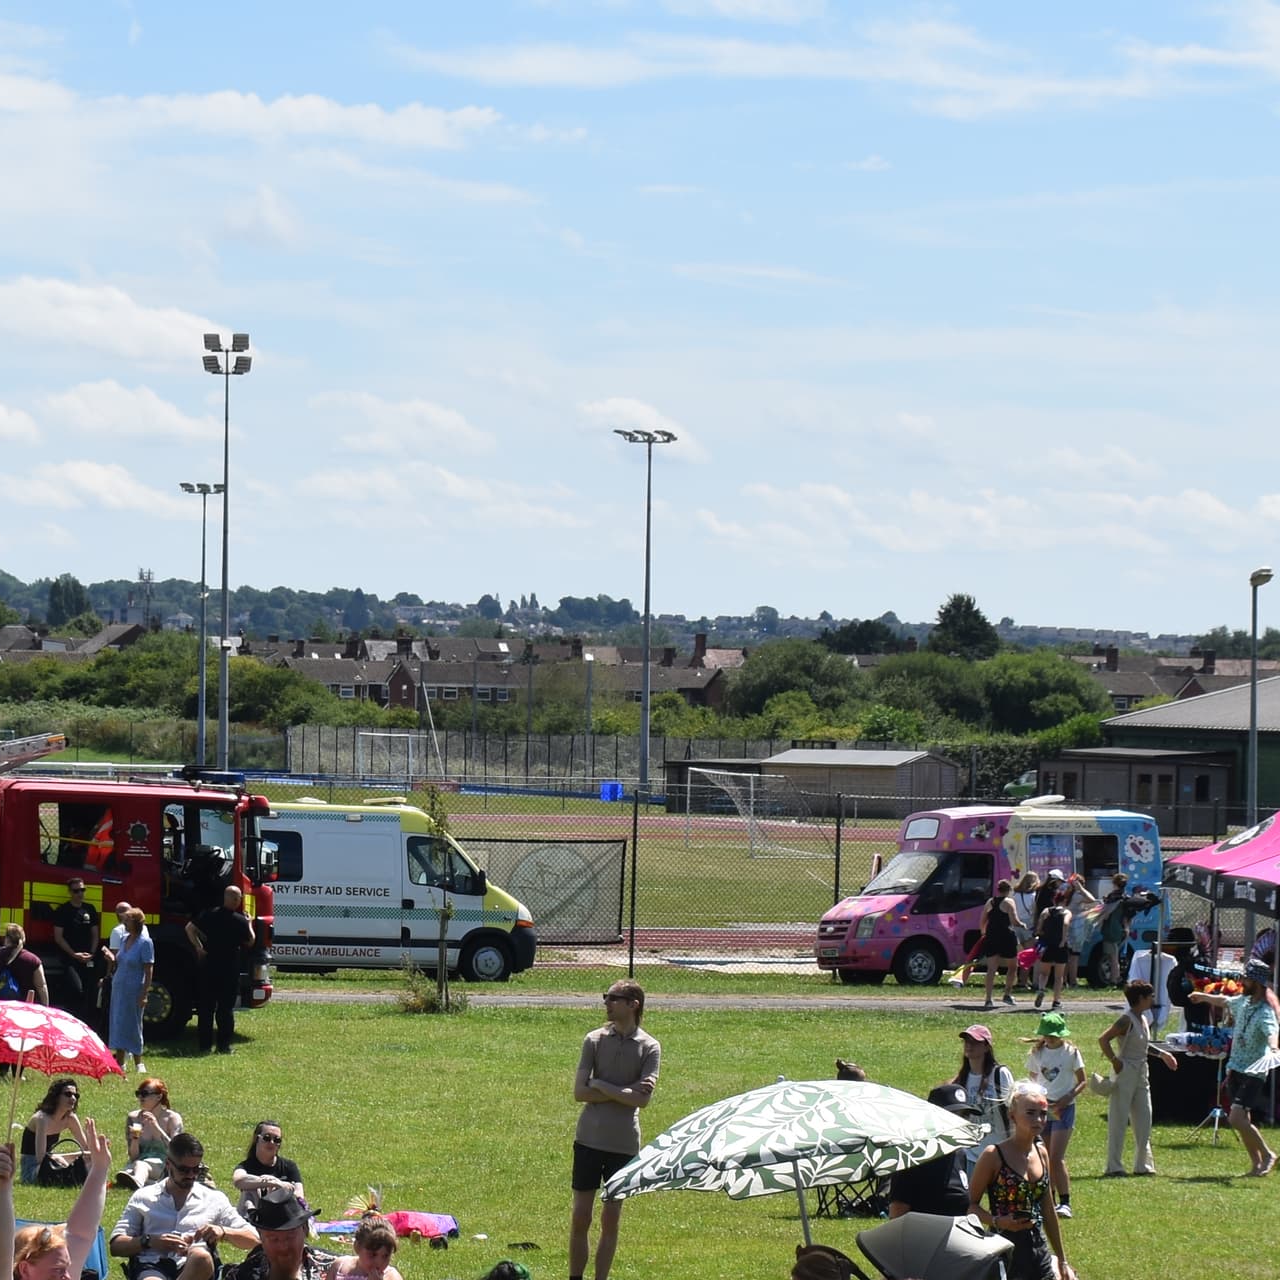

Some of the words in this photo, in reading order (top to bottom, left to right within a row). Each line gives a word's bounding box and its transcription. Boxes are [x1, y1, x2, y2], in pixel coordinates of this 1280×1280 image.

[269, 884, 291, 894] ARY
[293, 885, 325, 895] FIRST
[325, 886, 343, 896] AID
[345, 887, 390, 897] SERVICE
[268, 946, 314, 957] RGENCY
[315, 947, 381, 958] AMBULANCE
